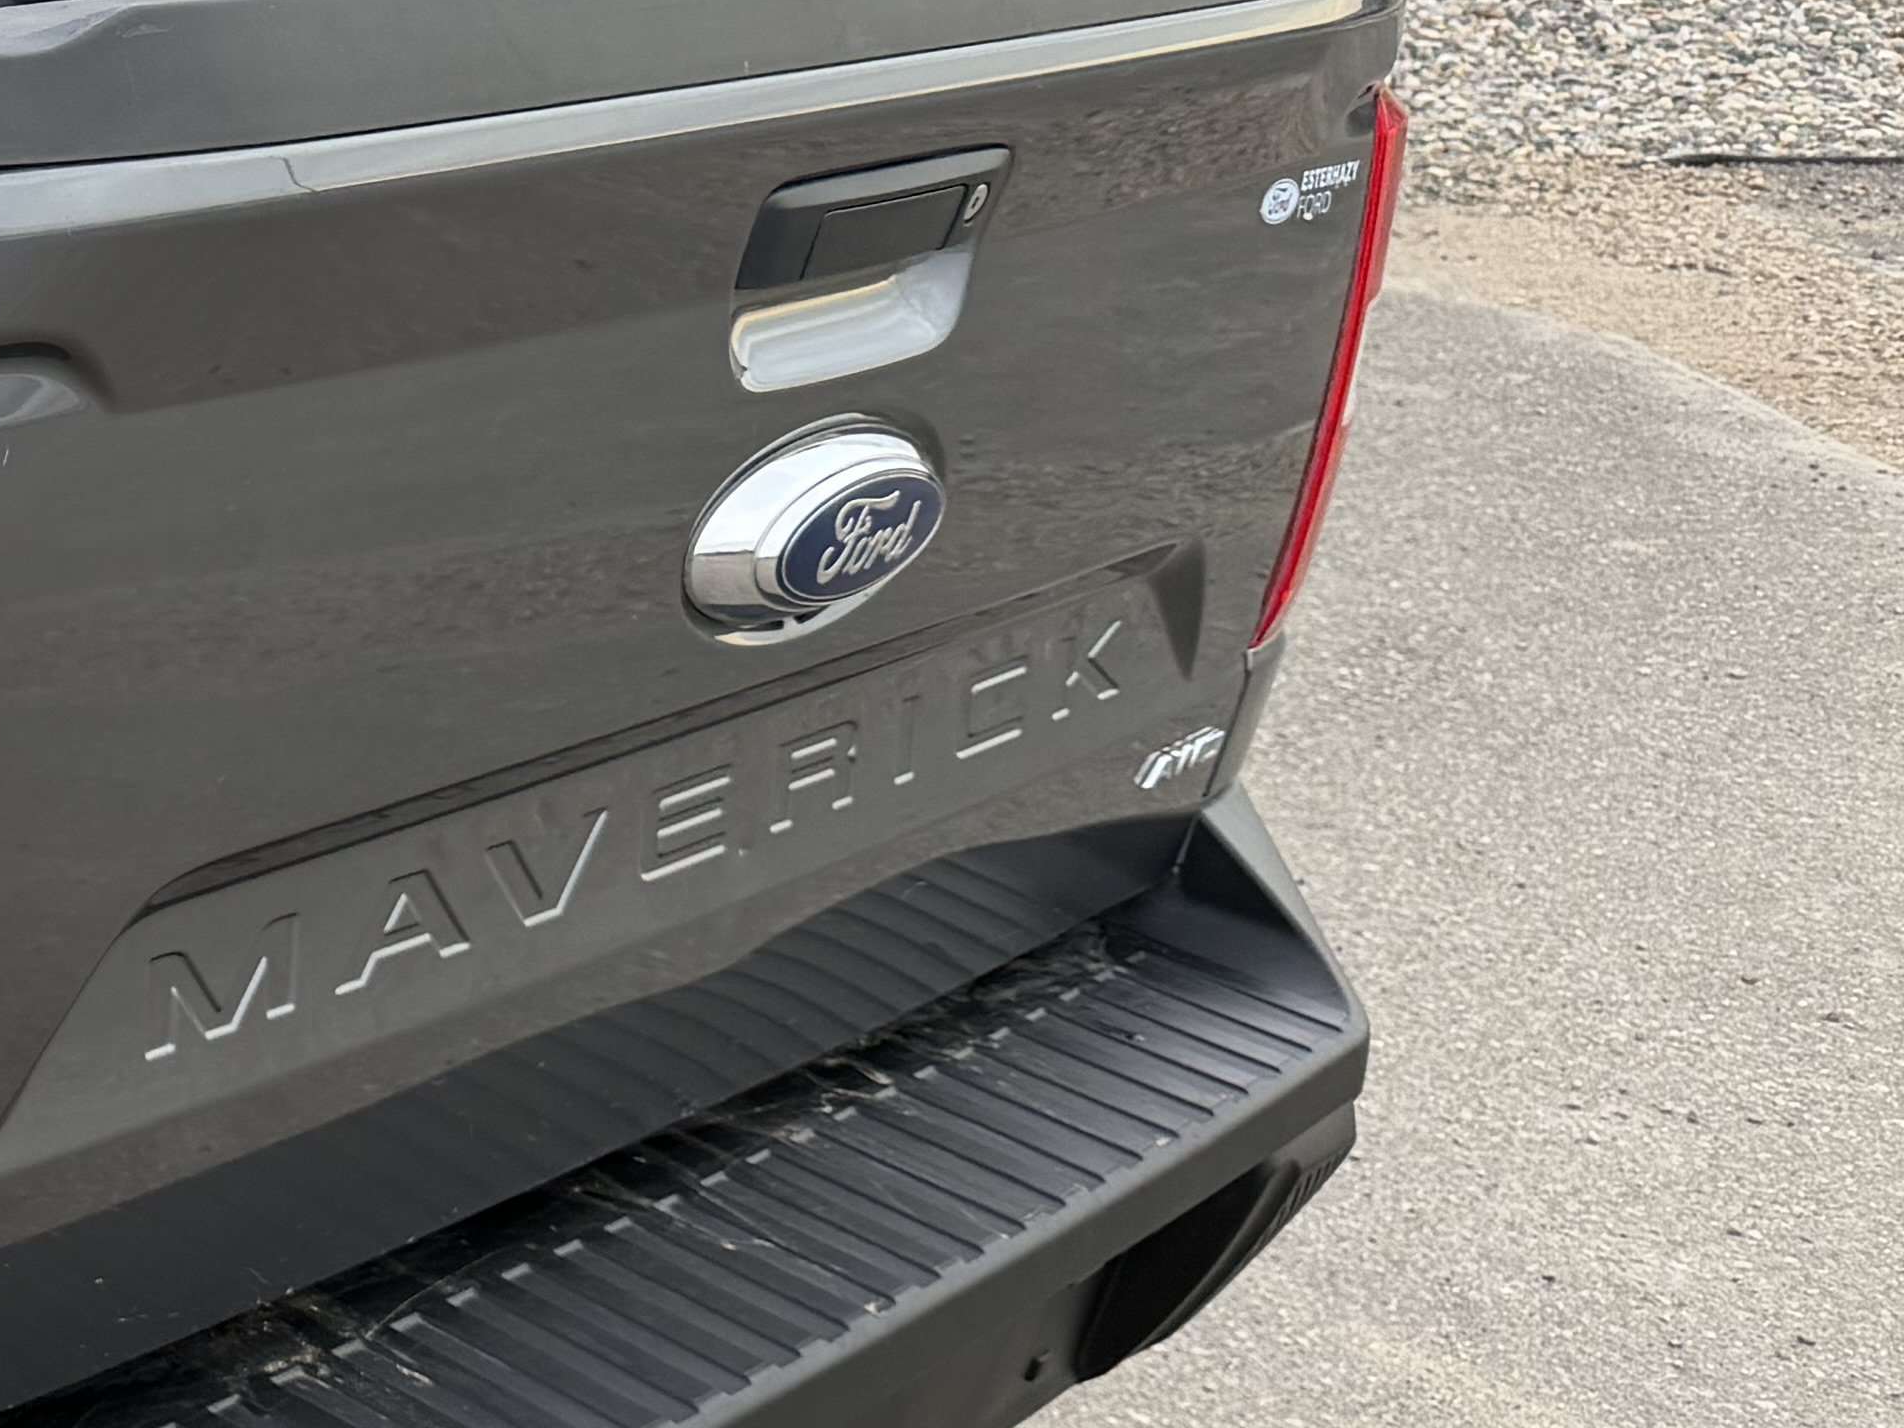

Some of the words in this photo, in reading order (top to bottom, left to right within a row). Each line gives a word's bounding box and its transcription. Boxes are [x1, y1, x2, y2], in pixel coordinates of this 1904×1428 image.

[1296, 190, 1332, 218] FORD
[1300, 158, 1360, 191] ESTERHAZY
[814, 488, 923, 586] Ford
[142, 618, 1126, 1063] MAVERICK
